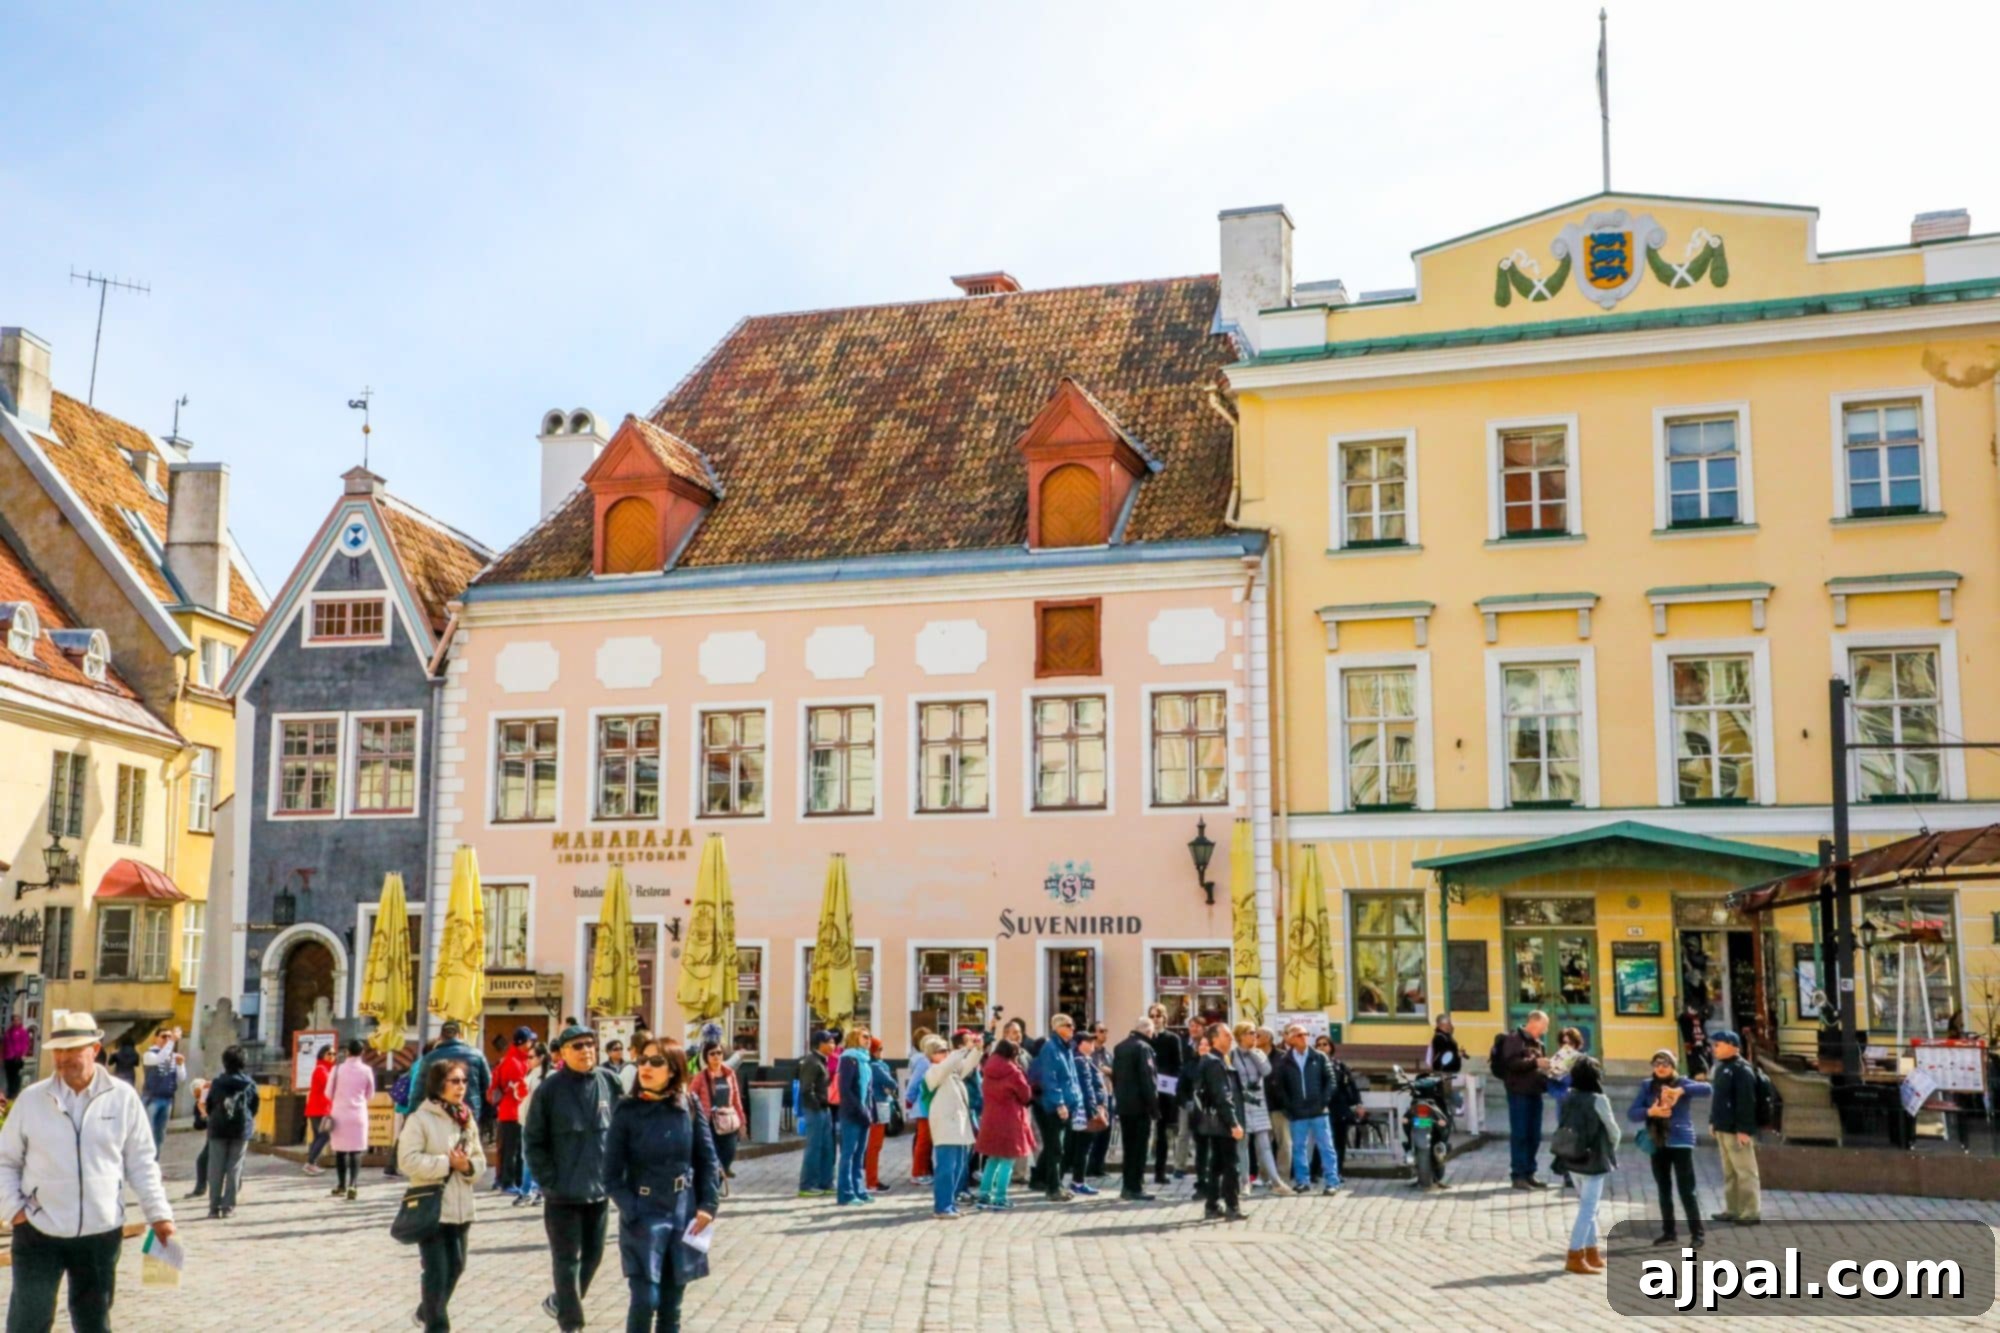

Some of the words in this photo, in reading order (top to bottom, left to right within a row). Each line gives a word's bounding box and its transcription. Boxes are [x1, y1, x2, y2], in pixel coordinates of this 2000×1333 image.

[552, 829, 693, 849] MAHARAJA
[557, 852, 599, 864] INDIA
[607, 851, 687, 862] RESTORAN
[636, 885, 671, 897] Restoran
[489, 978, 533, 991] juures
